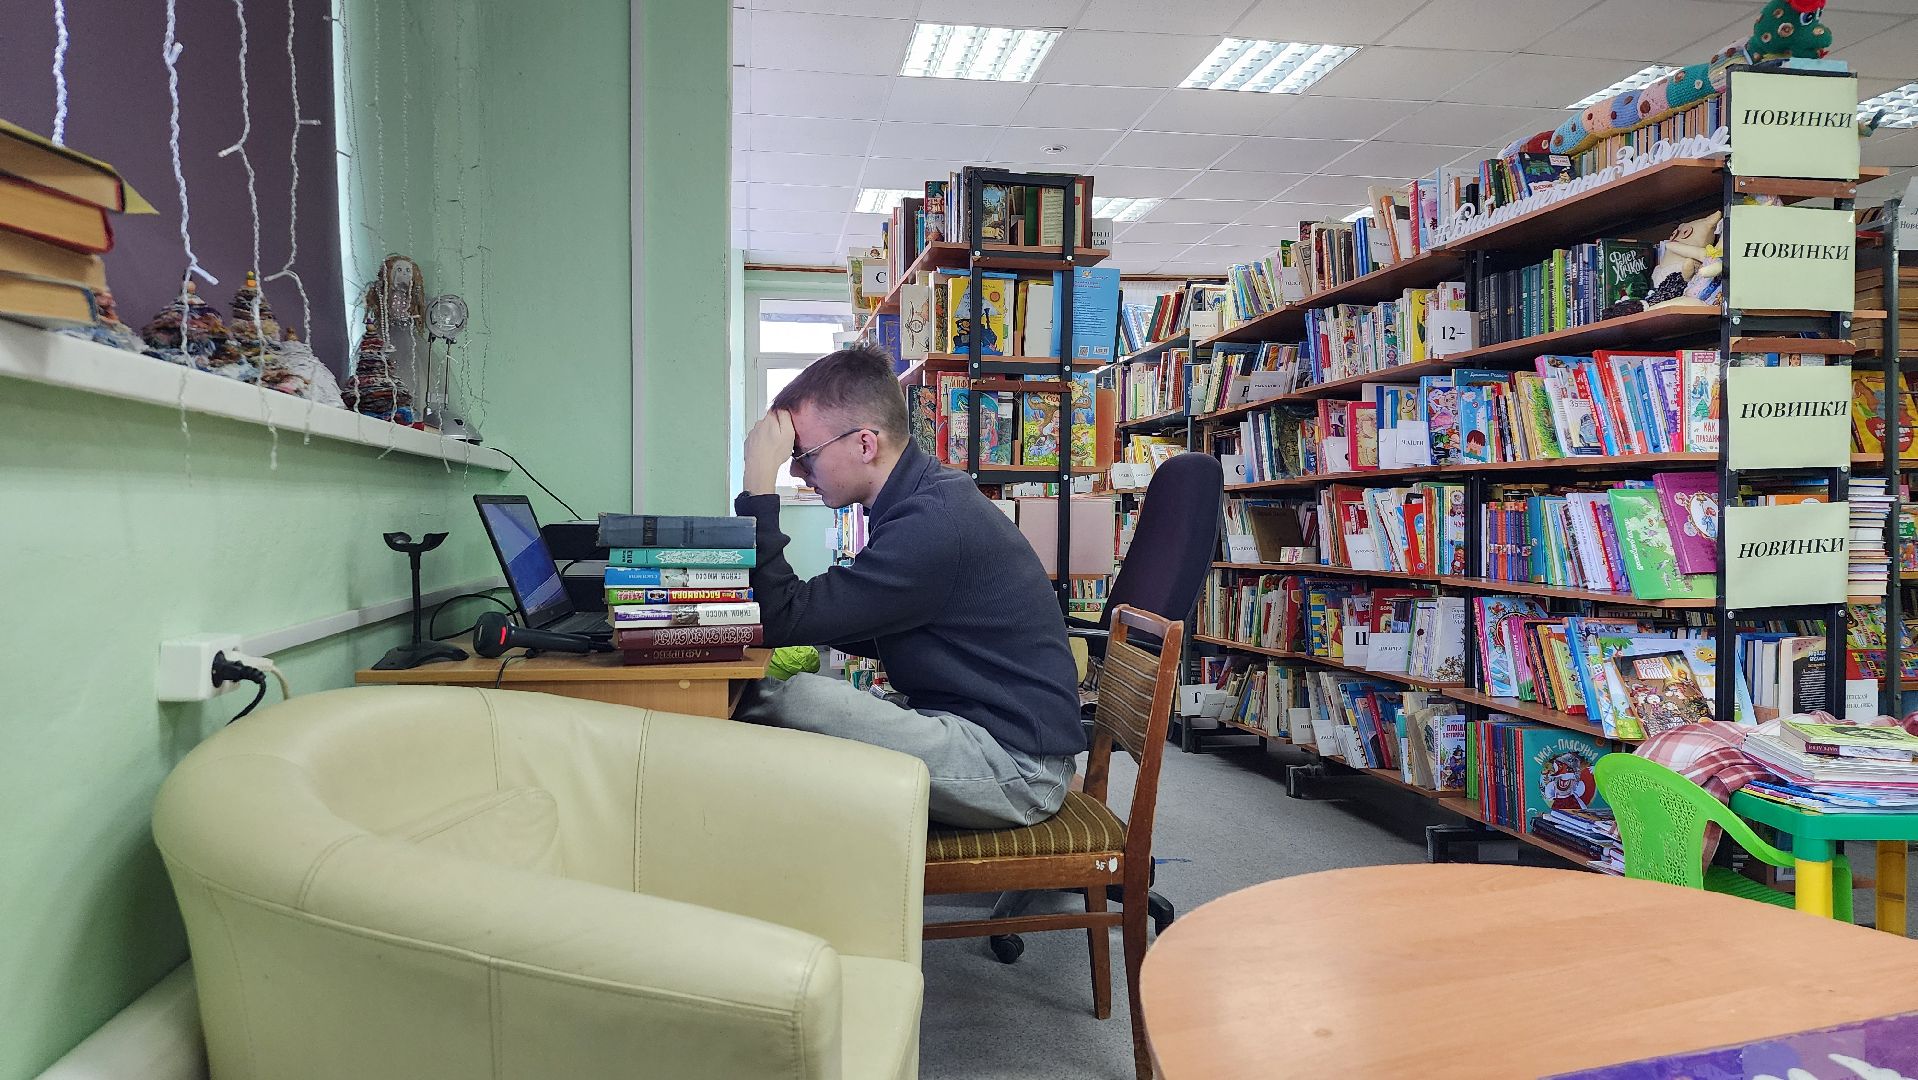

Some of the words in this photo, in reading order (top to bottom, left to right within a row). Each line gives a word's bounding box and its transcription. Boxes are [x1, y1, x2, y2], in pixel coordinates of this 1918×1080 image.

[1743, 108, 1853, 129] НОВИНКИ
[1742, 242, 1850, 261] НОВИНКИ
[1441, 325, 1466, 341] 12+
[1740, 400, 1848, 419] НОВИНКИ
[1703, 421, 1716, 432] КАК
[1737, 537, 1845, 559] НОВИНКИ
